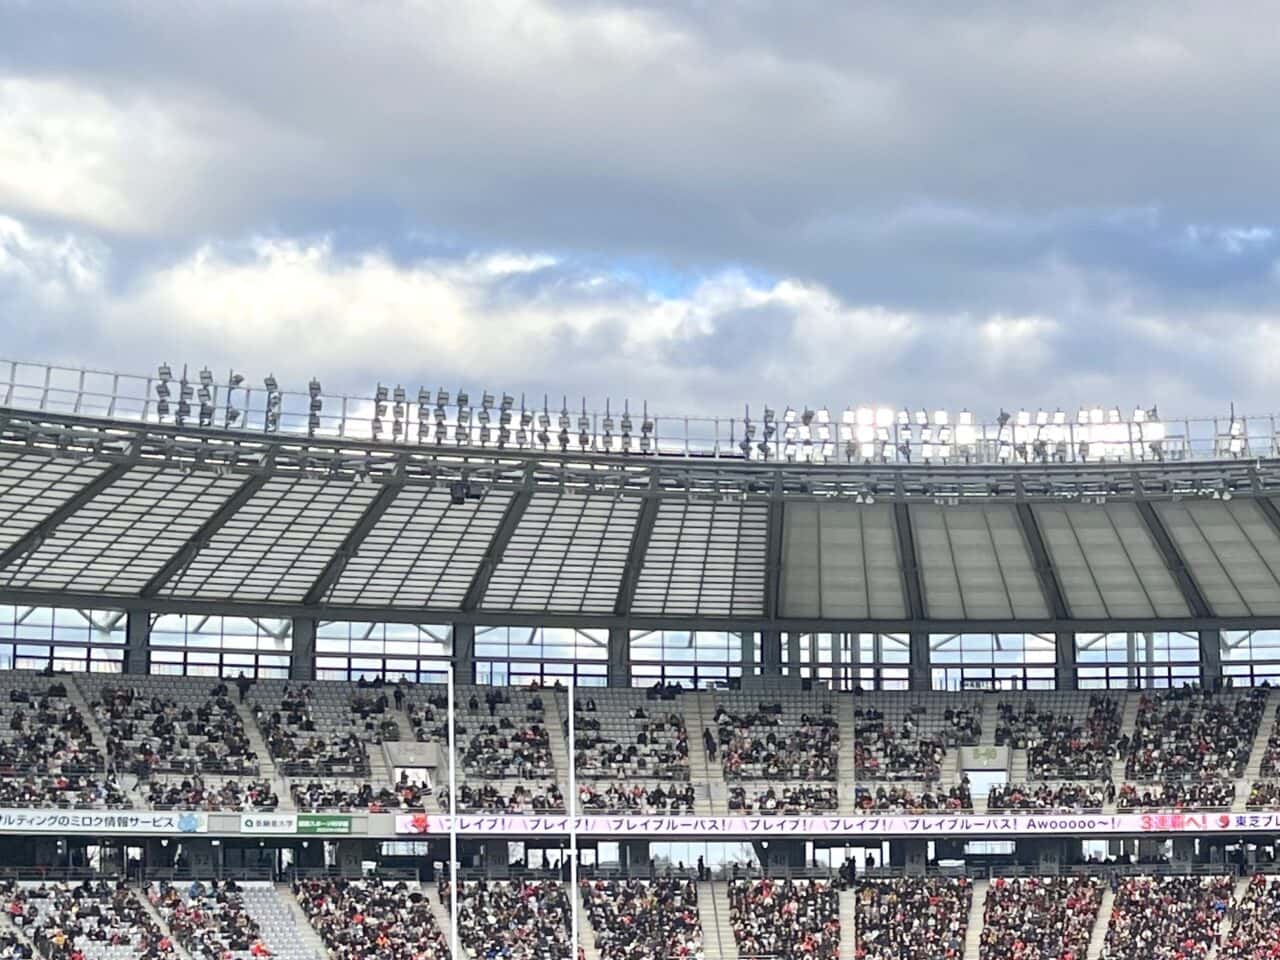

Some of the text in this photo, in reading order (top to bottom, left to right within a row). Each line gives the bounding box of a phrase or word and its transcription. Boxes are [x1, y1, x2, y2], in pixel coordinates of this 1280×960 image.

[0, 815, 175, 828] ルティングのミロク情報サービス
[750, 818, 807, 831] ブレイブ!
[830, 818, 886, 831] ブレイブ!
